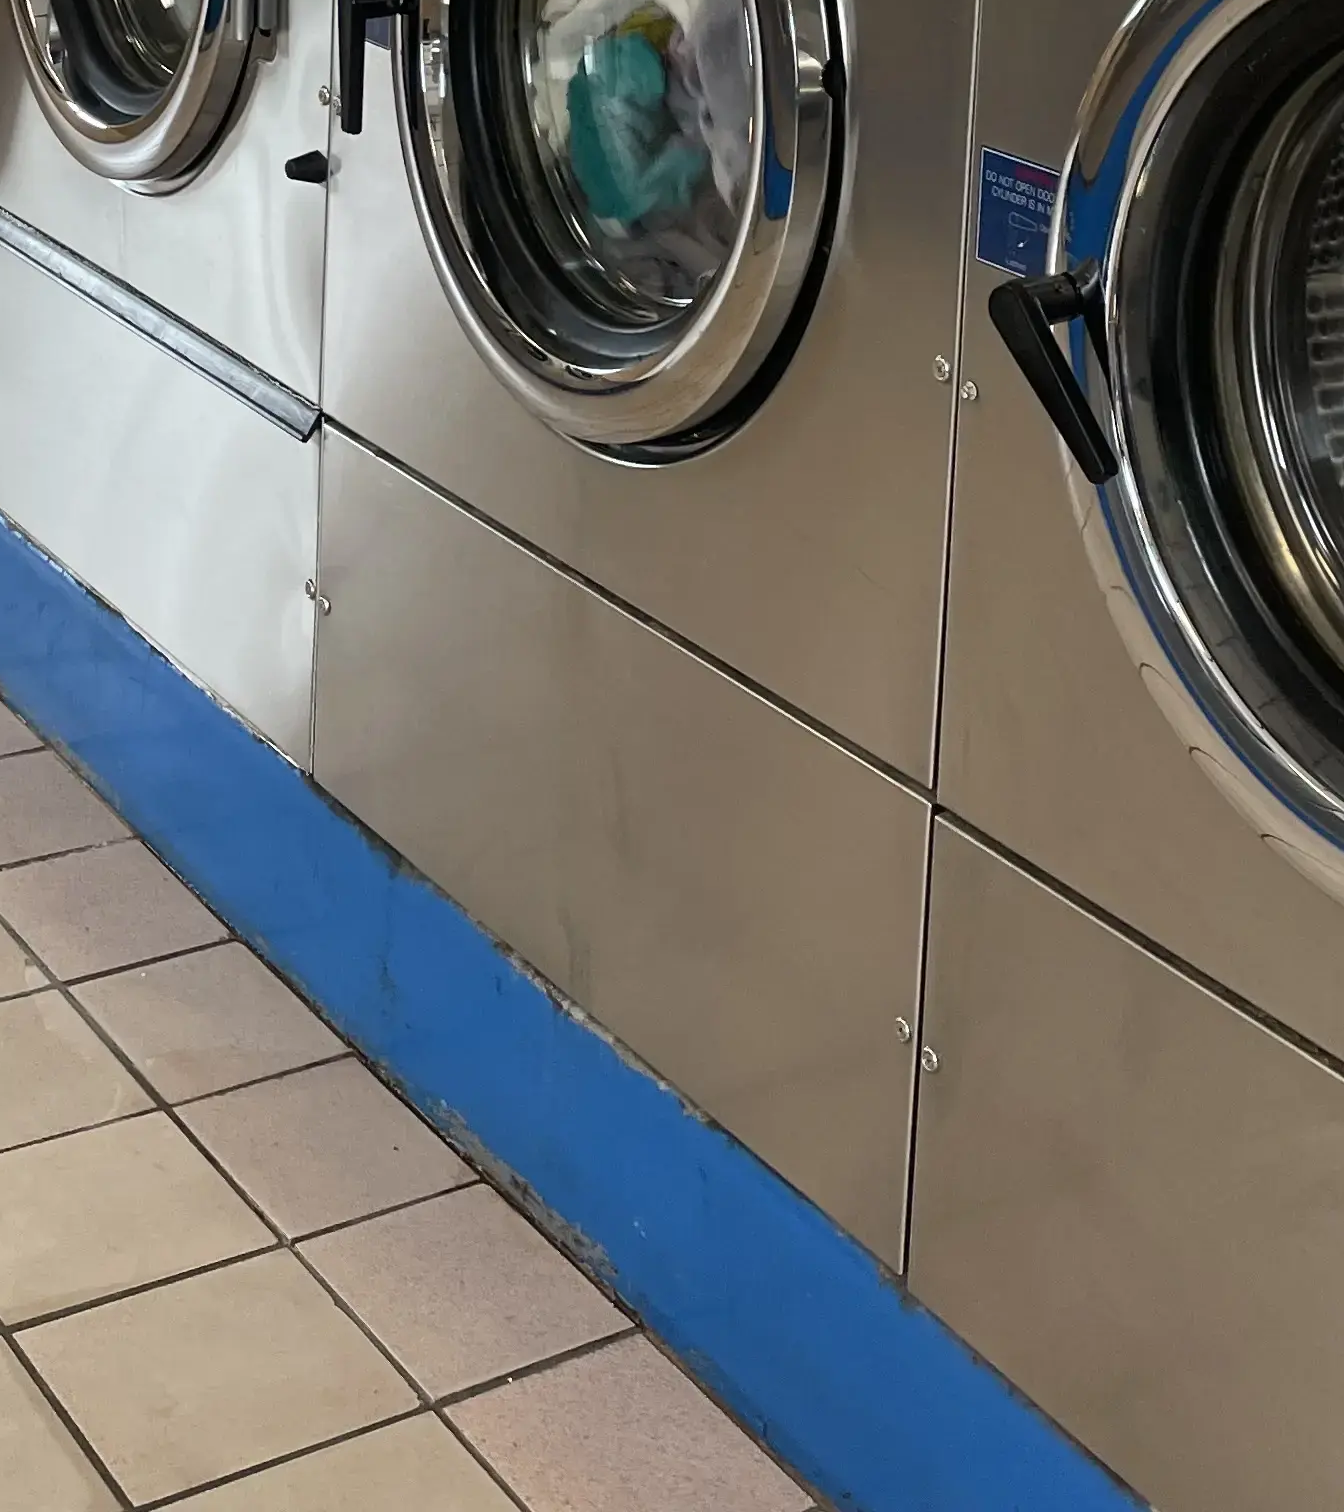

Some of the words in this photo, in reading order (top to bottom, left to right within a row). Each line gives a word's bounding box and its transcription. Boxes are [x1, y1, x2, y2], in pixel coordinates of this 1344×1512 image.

[985, 169, 997, 183] DO
[998, 174, 1015, 188] NOT
[1015, 180, 1036, 197] OPEN
[1037, 188, 1055, 204] DOO
[1028, 199, 1036, 211] IS
[1037, 202, 1045, 214] IN
